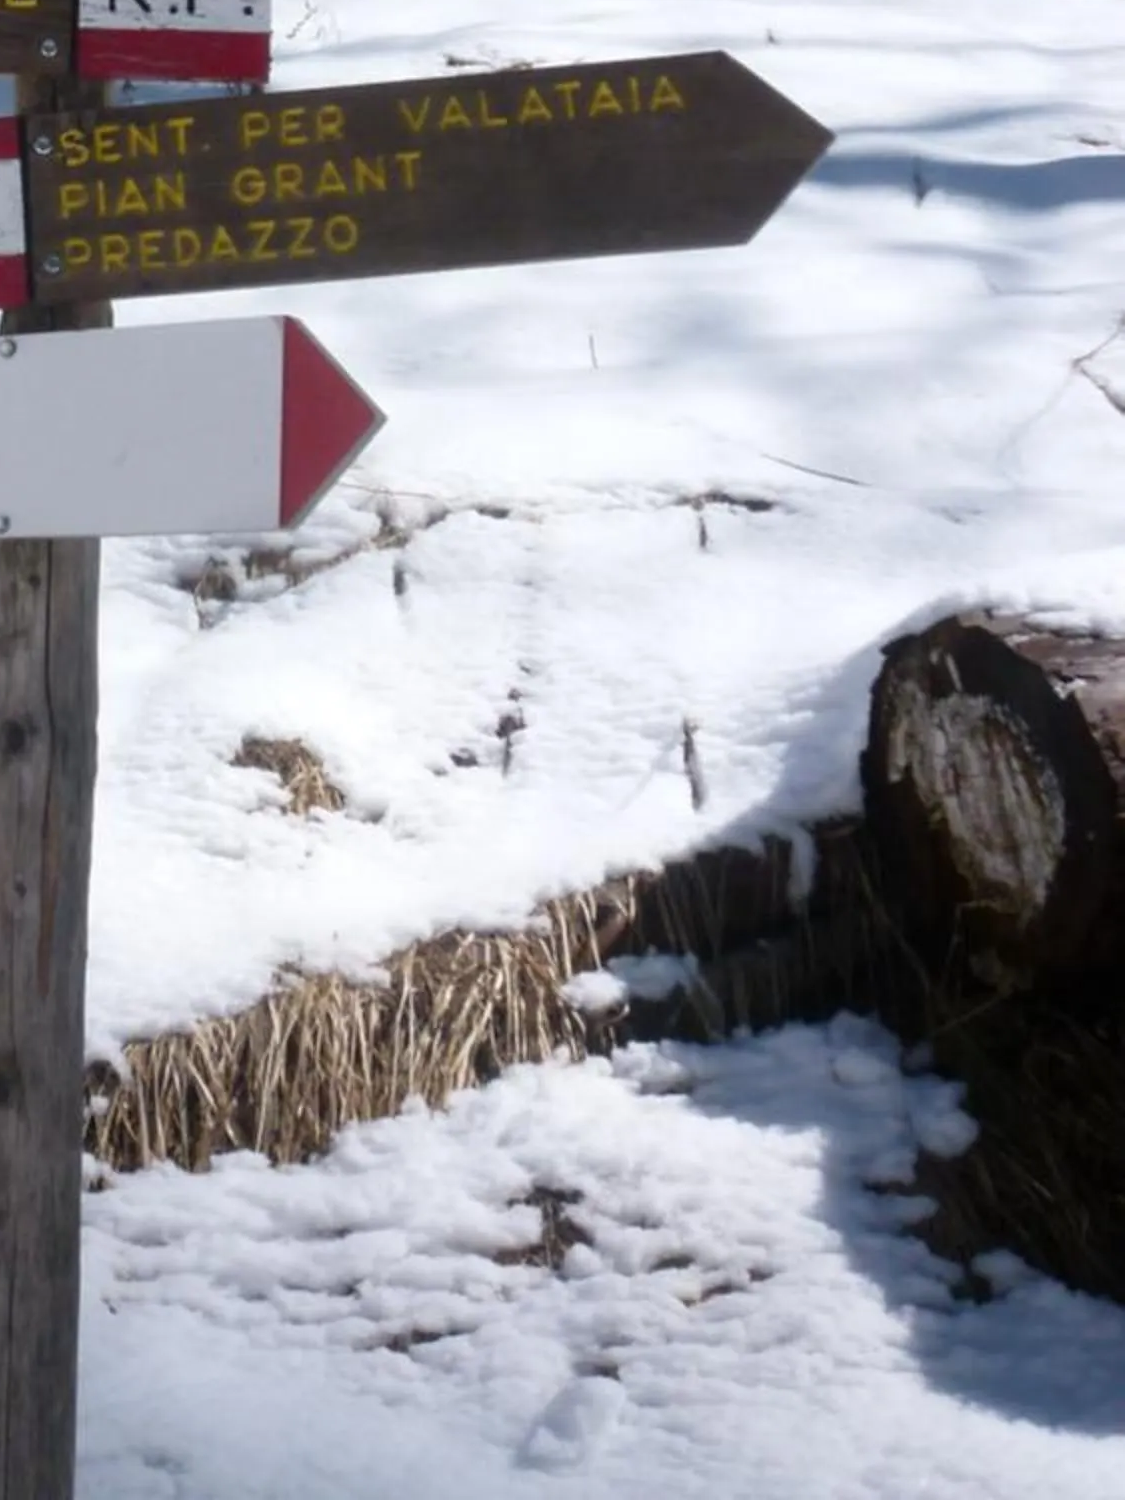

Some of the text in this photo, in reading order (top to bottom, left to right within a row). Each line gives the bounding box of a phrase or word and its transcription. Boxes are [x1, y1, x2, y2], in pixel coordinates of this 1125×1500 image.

[241, 107, 348, 150] PER
[400, 74, 685, 132] VALATAIA
[59, 150, 425, 220] PIAN GRANT
[59, 217, 361, 276] PREDAZZO
